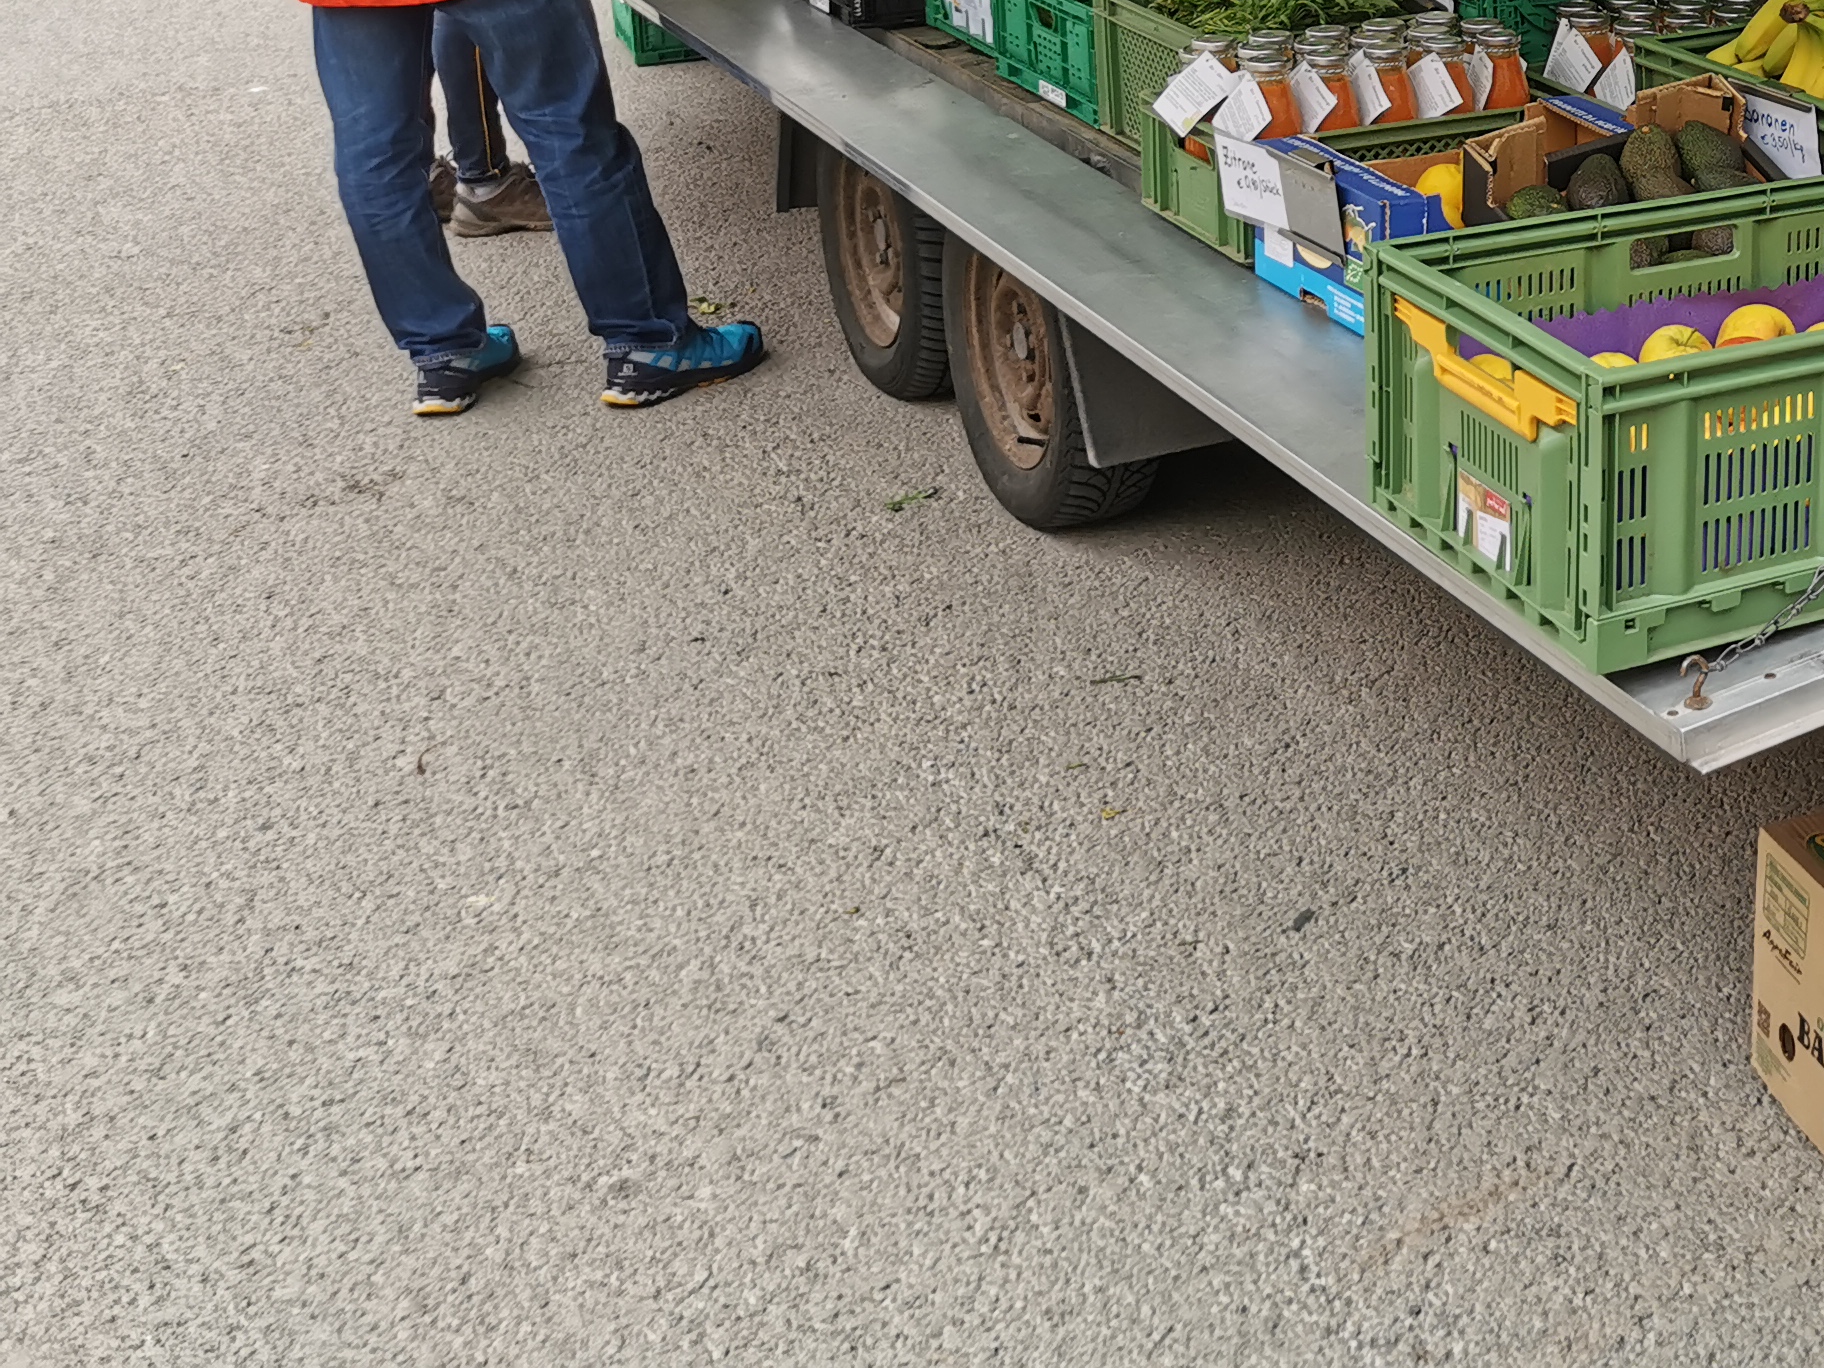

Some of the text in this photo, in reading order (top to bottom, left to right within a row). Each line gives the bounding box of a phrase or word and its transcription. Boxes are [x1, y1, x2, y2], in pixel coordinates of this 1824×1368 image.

[1222, 145, 1258, 175] Zitrone
[1760, 133, 1806, 164] € 3,50/kg
[1236, 179, 1244, 190] €
